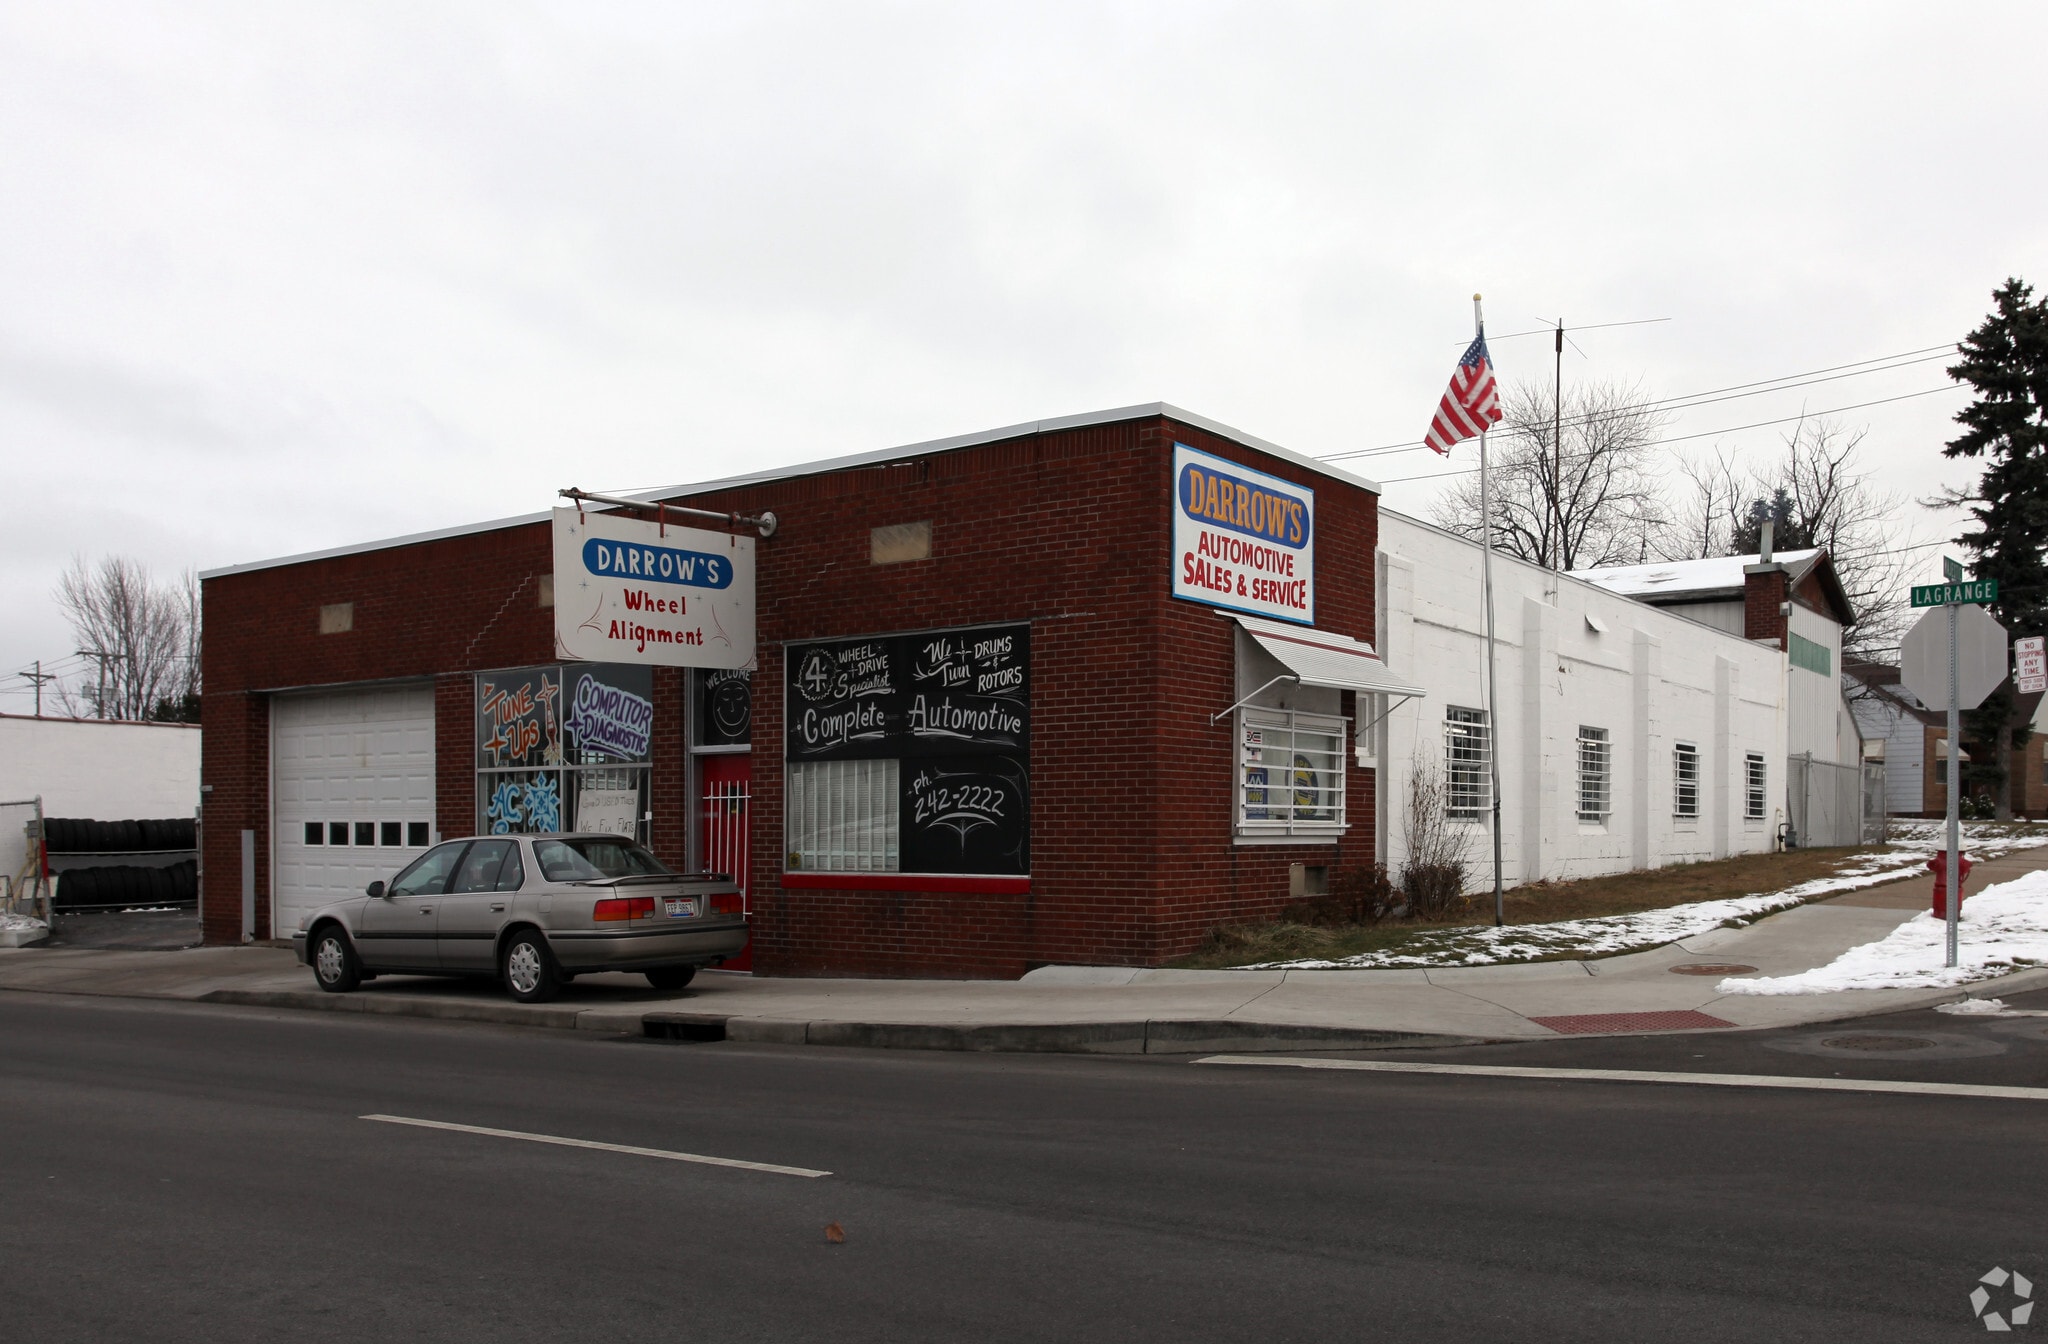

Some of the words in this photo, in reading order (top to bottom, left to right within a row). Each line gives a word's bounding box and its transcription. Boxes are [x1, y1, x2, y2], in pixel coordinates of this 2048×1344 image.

[1189, 469, 1302, 544] DARROW'S
[597, 544, 720, 584] DARROW'S
[1198, 531, 1294, 577] AUTOMOTIVE
[1183, 551, 1232, 594] SALES
[1236, 573, 1247, 597] &
[1252, 577, 1306, 610] SERVICE
[1916, 582, 1992, 605] LAGRANGE
[623, 588, 686, 615] Wheel
[608, 619, 704, 653] Alignment
[974, 635, 1012, 660] DRUMS
[2024, 642, 2035, 650] NO
[838, 644, 876, 664] WHEEL
[923, 638, 952, 663] We
[2018, 650, 2045, 660] STOPPING
[2024, 659, 2038, 668] ANY
[805, 656, 827, 692] 4
[858, 654, 889, 677] DRIVE
[928, 662, 971, 687] Turn
[2024, 667, 2040, 675] TIME
[705, 669, 750, 690] WELCOME
[834, 671, 891, 699] Specialist
[977, 666, 1022, 693] ROTORS
[577, 673, 653, 734] COMPUTOR
[804, 702, 885, 743] Complete
[908, 694, 1021, 734] Automotive
[580, 714, 649, 756] DIAGNOSTIC
[488, 782, 522, 823] AC
[915, 785, 1005, 823] 242-2222
